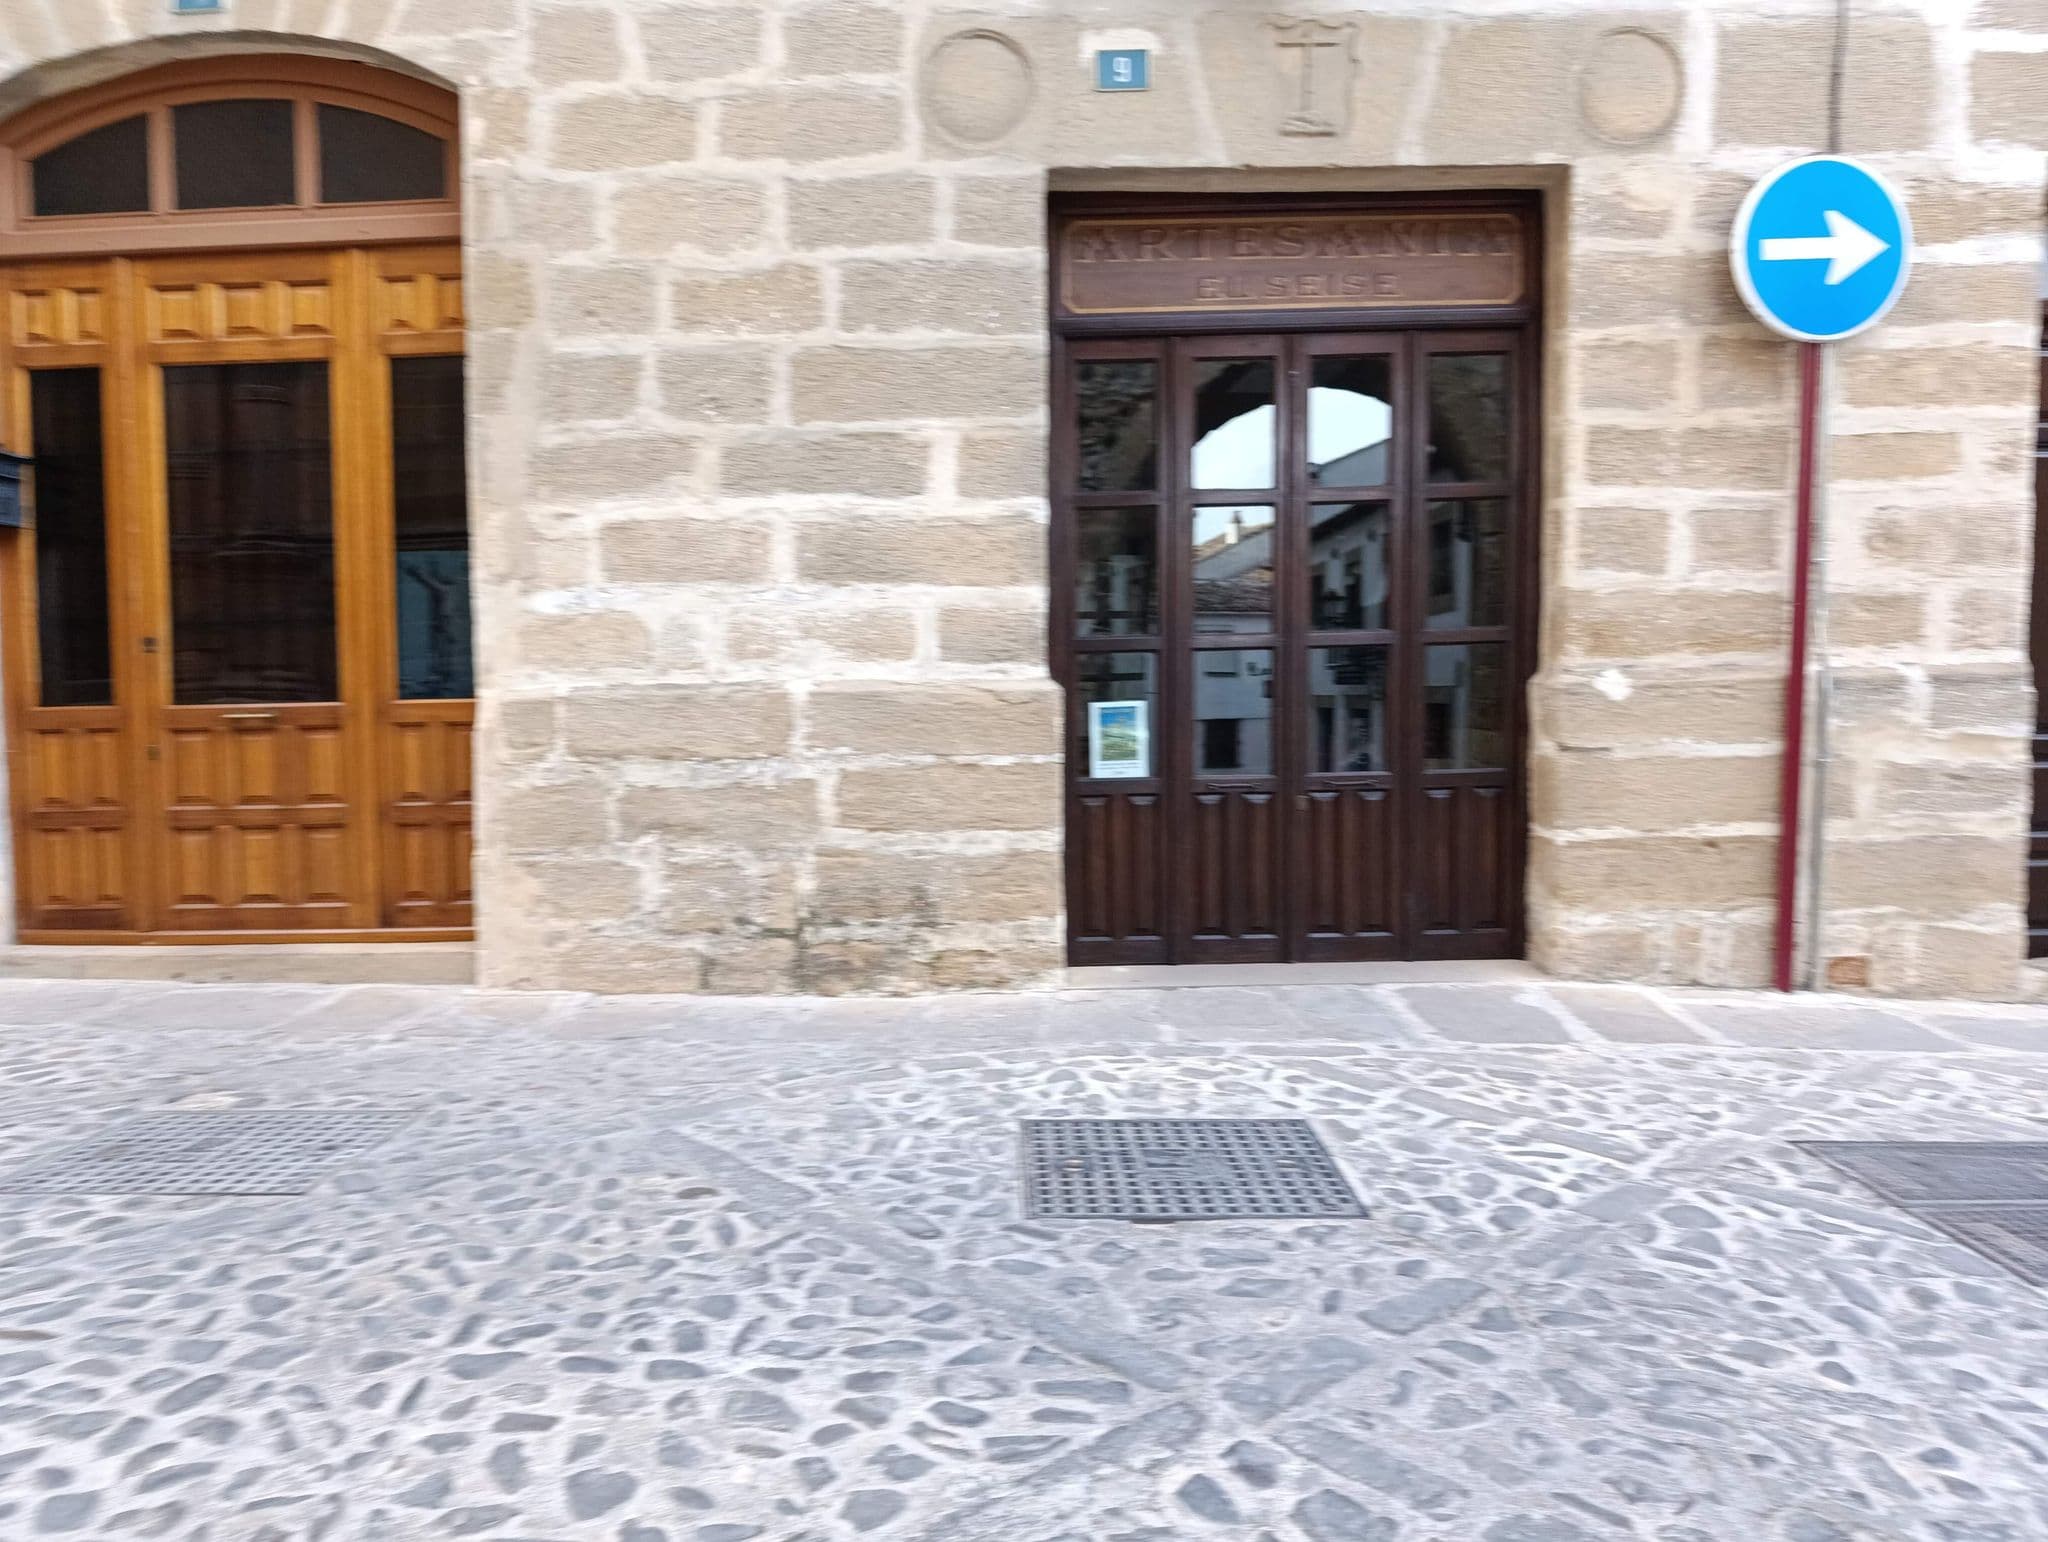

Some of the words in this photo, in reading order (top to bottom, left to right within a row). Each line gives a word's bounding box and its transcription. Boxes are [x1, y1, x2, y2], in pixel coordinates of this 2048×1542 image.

[1113, 57, 1132, 82] 9
[1074, 221, 1514, 263] ARTESANIA
[1195, 275, 1256, 301] EL
[1262, 272, 1402, 299] SEISE
